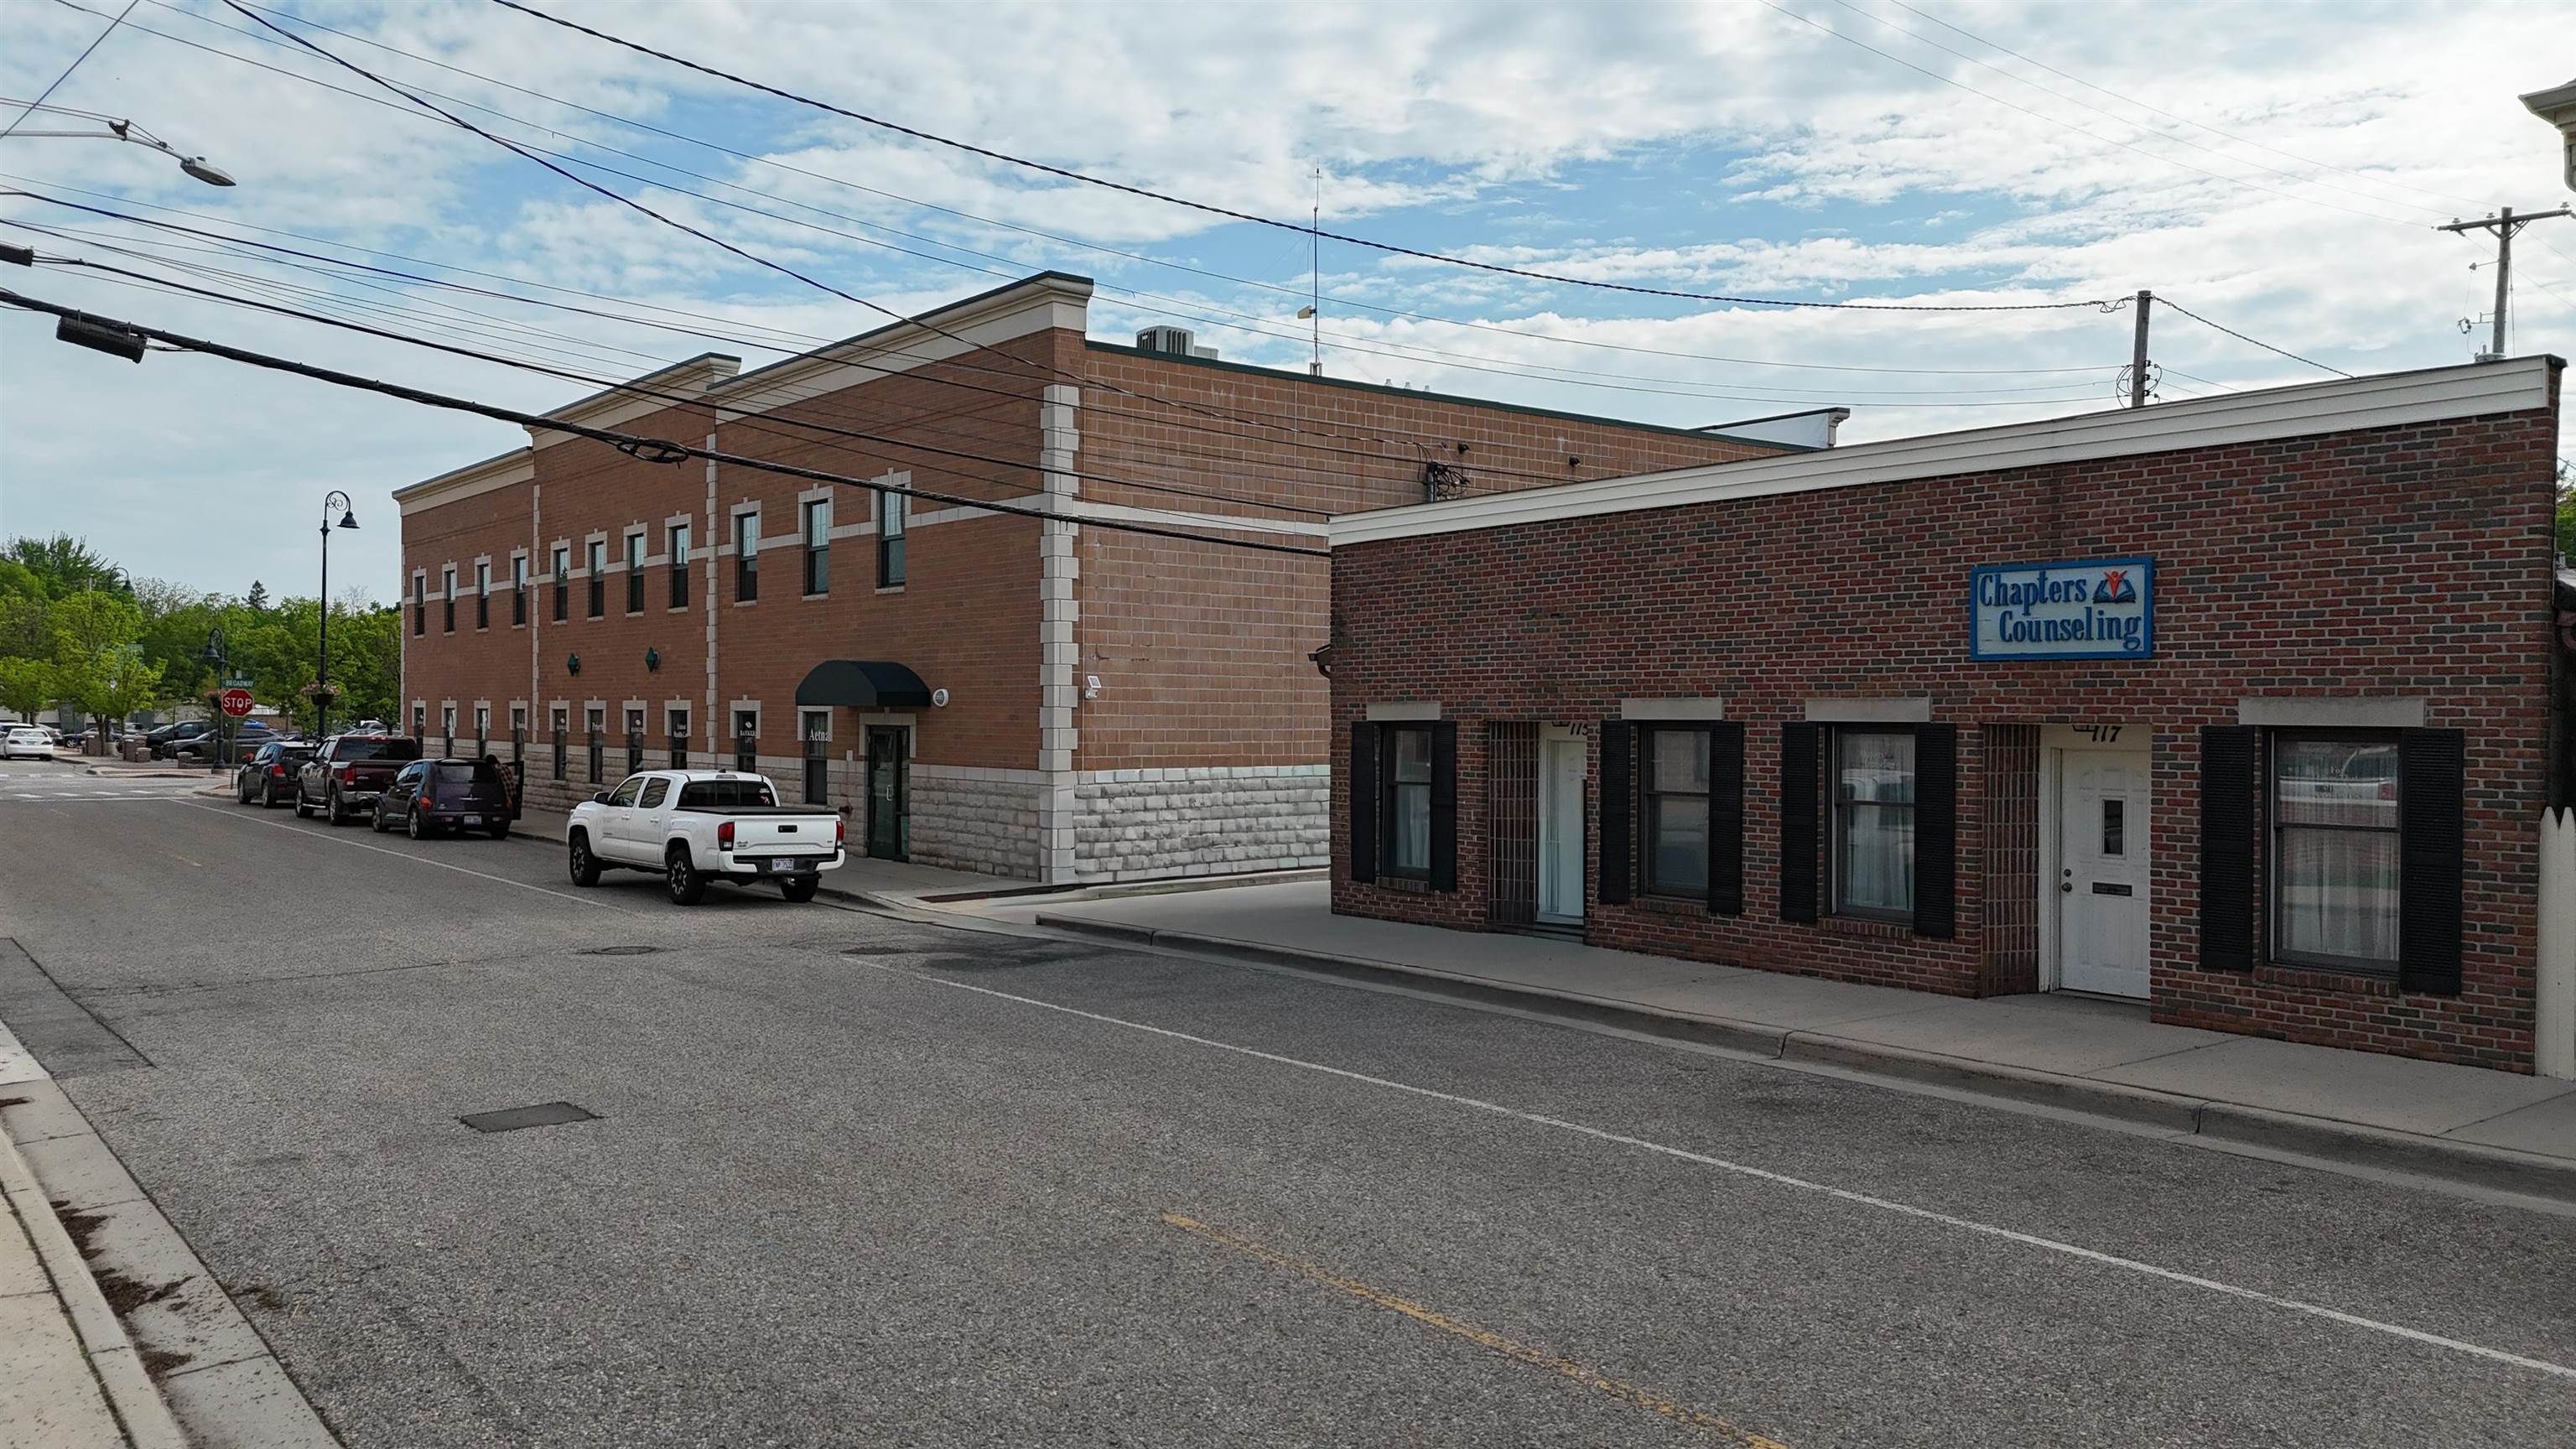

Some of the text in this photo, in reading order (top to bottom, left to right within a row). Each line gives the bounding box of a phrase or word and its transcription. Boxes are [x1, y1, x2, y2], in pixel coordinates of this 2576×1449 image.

[1980, 571, 2087, 615] Chapters
[1998, 605, 2142, 650] Counseling
[224, 697, 252, 709] STOP
[808, 727, 830, 741] Aetna
[1571, 723, 1588, 736] 115
[2092, 725, 2122, 742] 117
